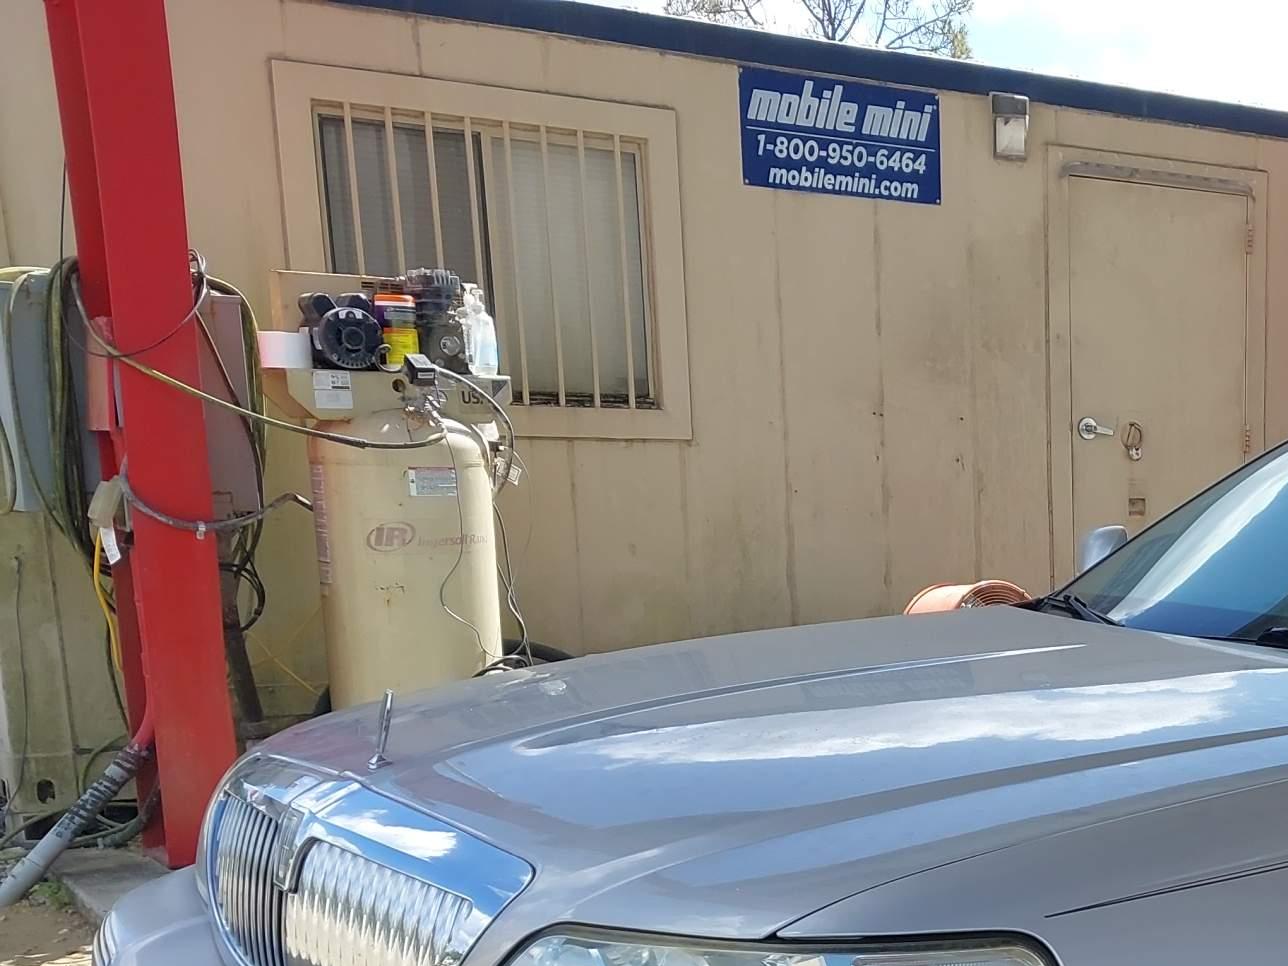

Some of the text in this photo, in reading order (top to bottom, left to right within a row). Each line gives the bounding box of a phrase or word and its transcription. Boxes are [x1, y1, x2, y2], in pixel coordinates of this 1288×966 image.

[747, 80, 932, 142] mobile mini
[756, 133, 926, 175] 1-800-950-6464
[768, 166, 919, 199] mobilemini.com
